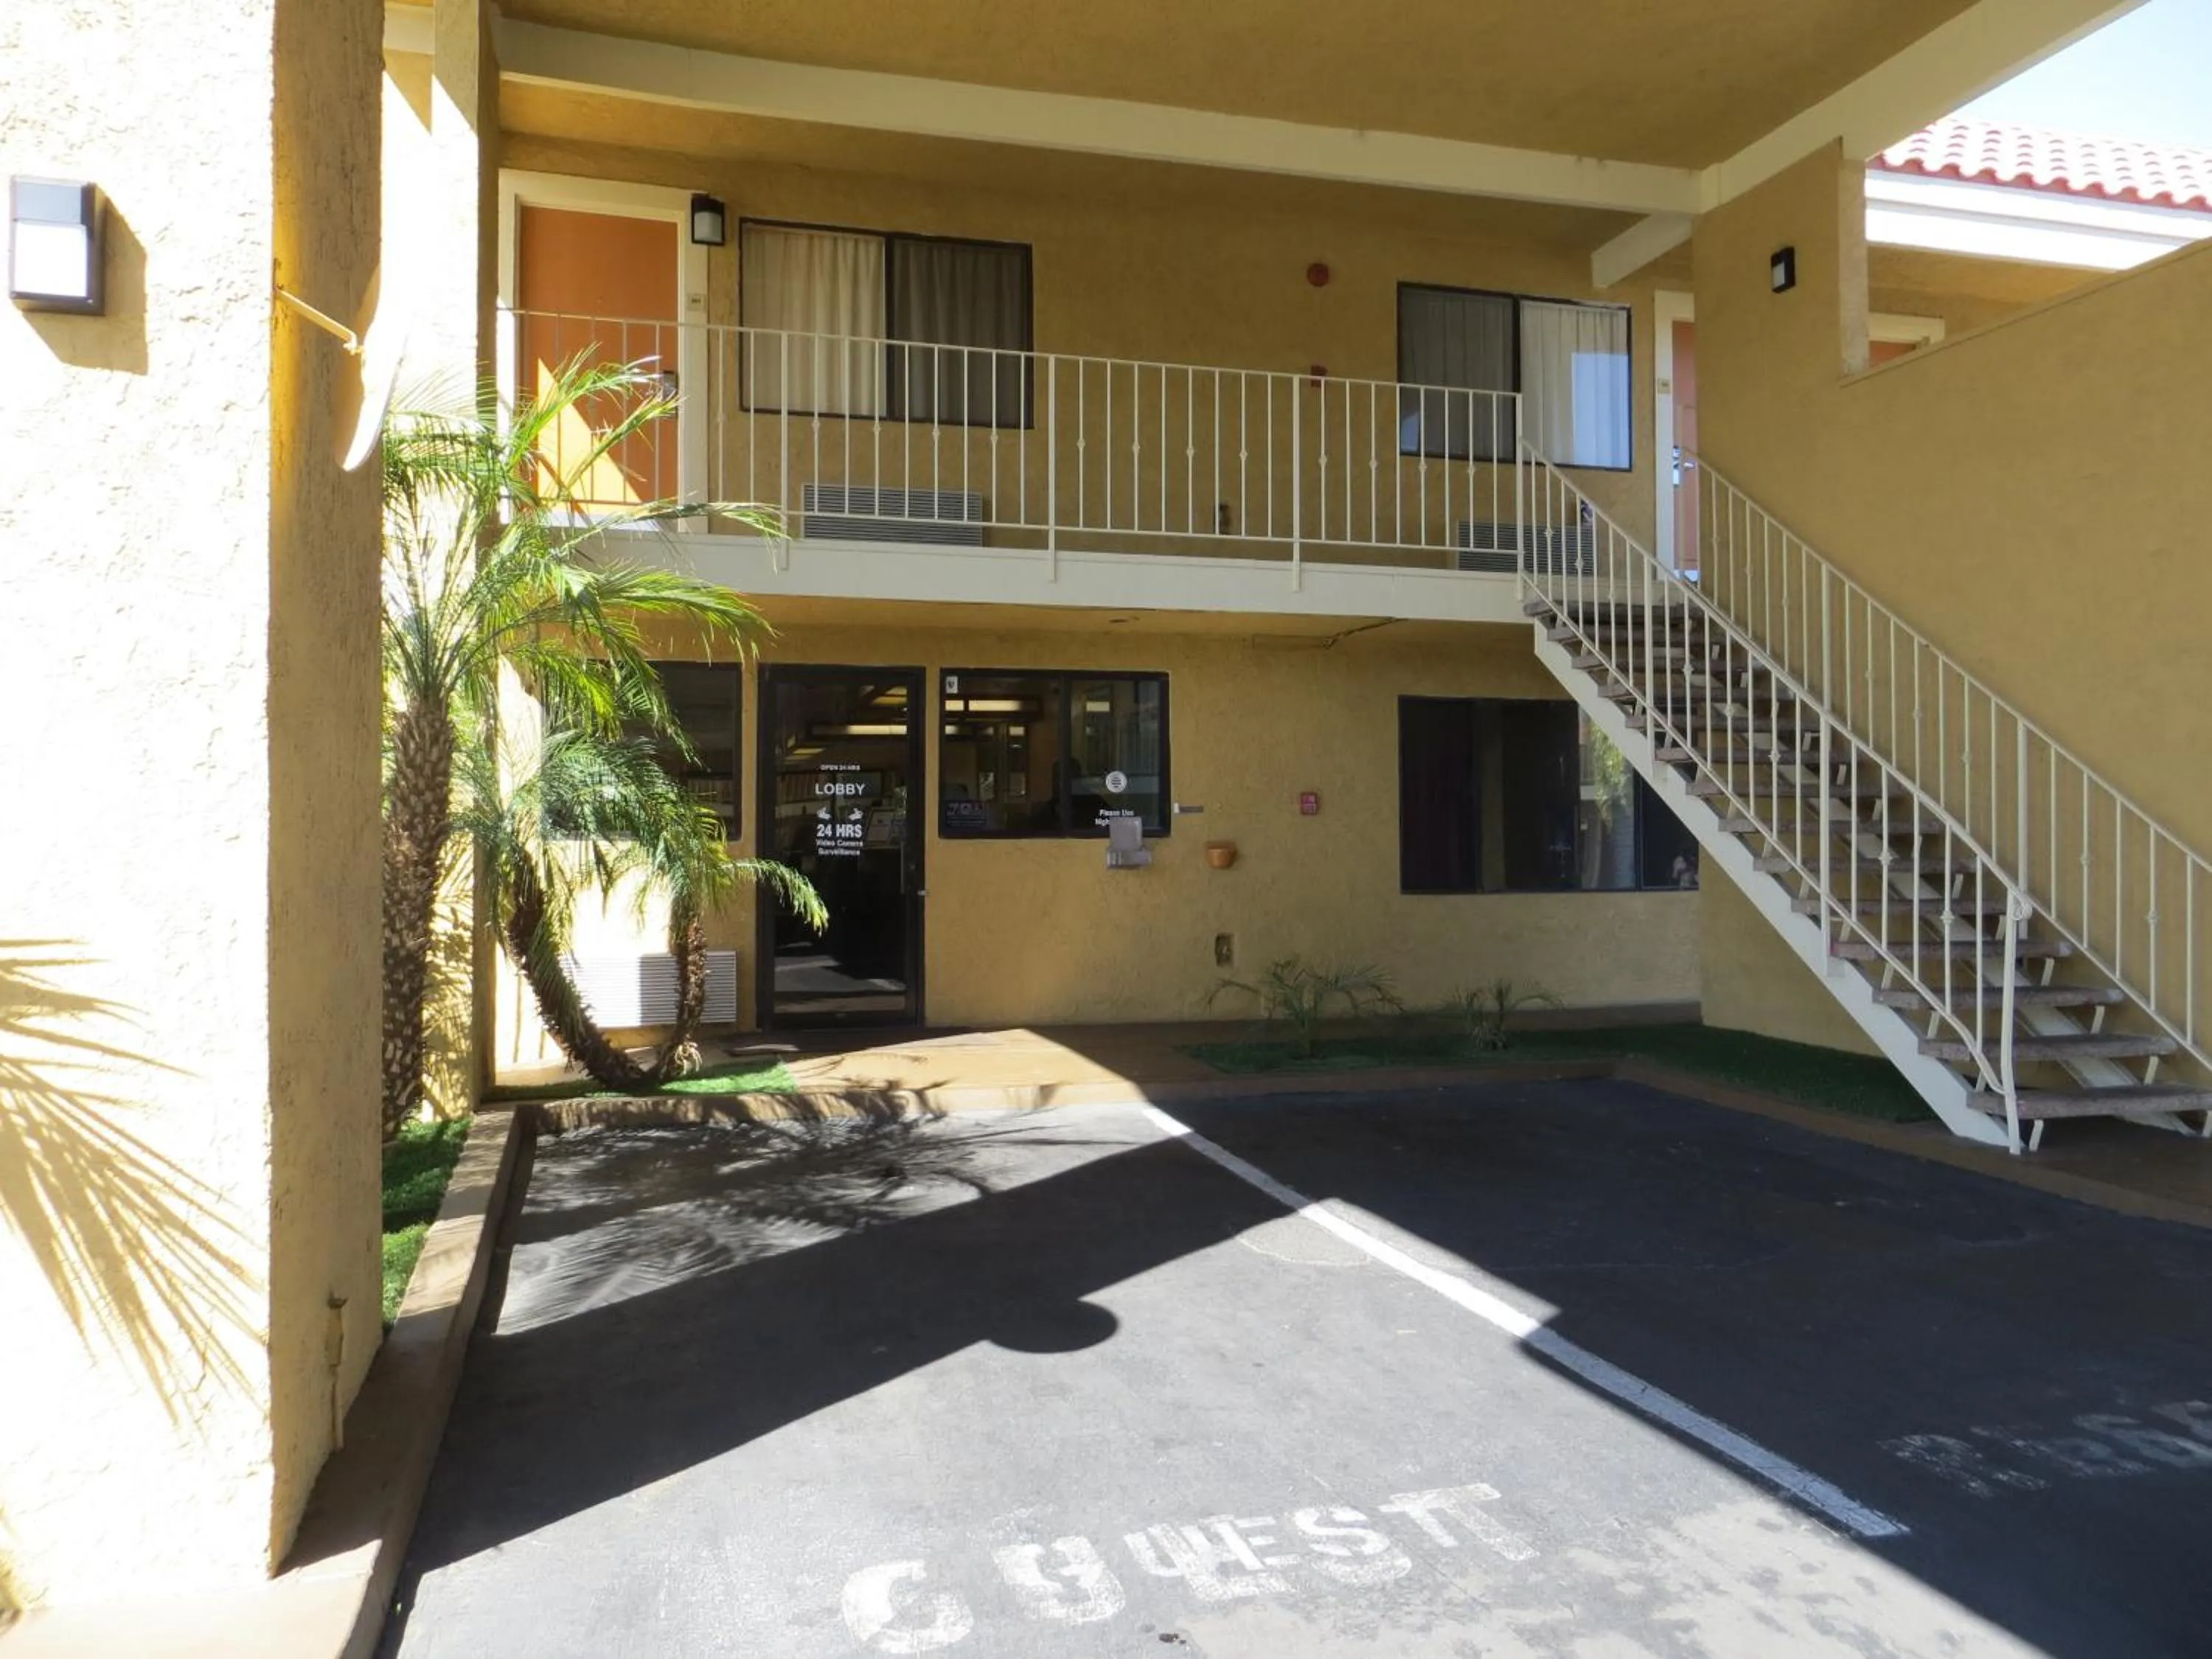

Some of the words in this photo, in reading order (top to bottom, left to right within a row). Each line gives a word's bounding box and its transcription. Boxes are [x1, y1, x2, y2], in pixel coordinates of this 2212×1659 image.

[815, 783, 865, 796] LOBBY
[816, 824, 832, 837] 24
[835, 824, 863, 838] HRS
[815, 838, 835, 846] Video
[840, 1482, 1540, 1654] GUEST
